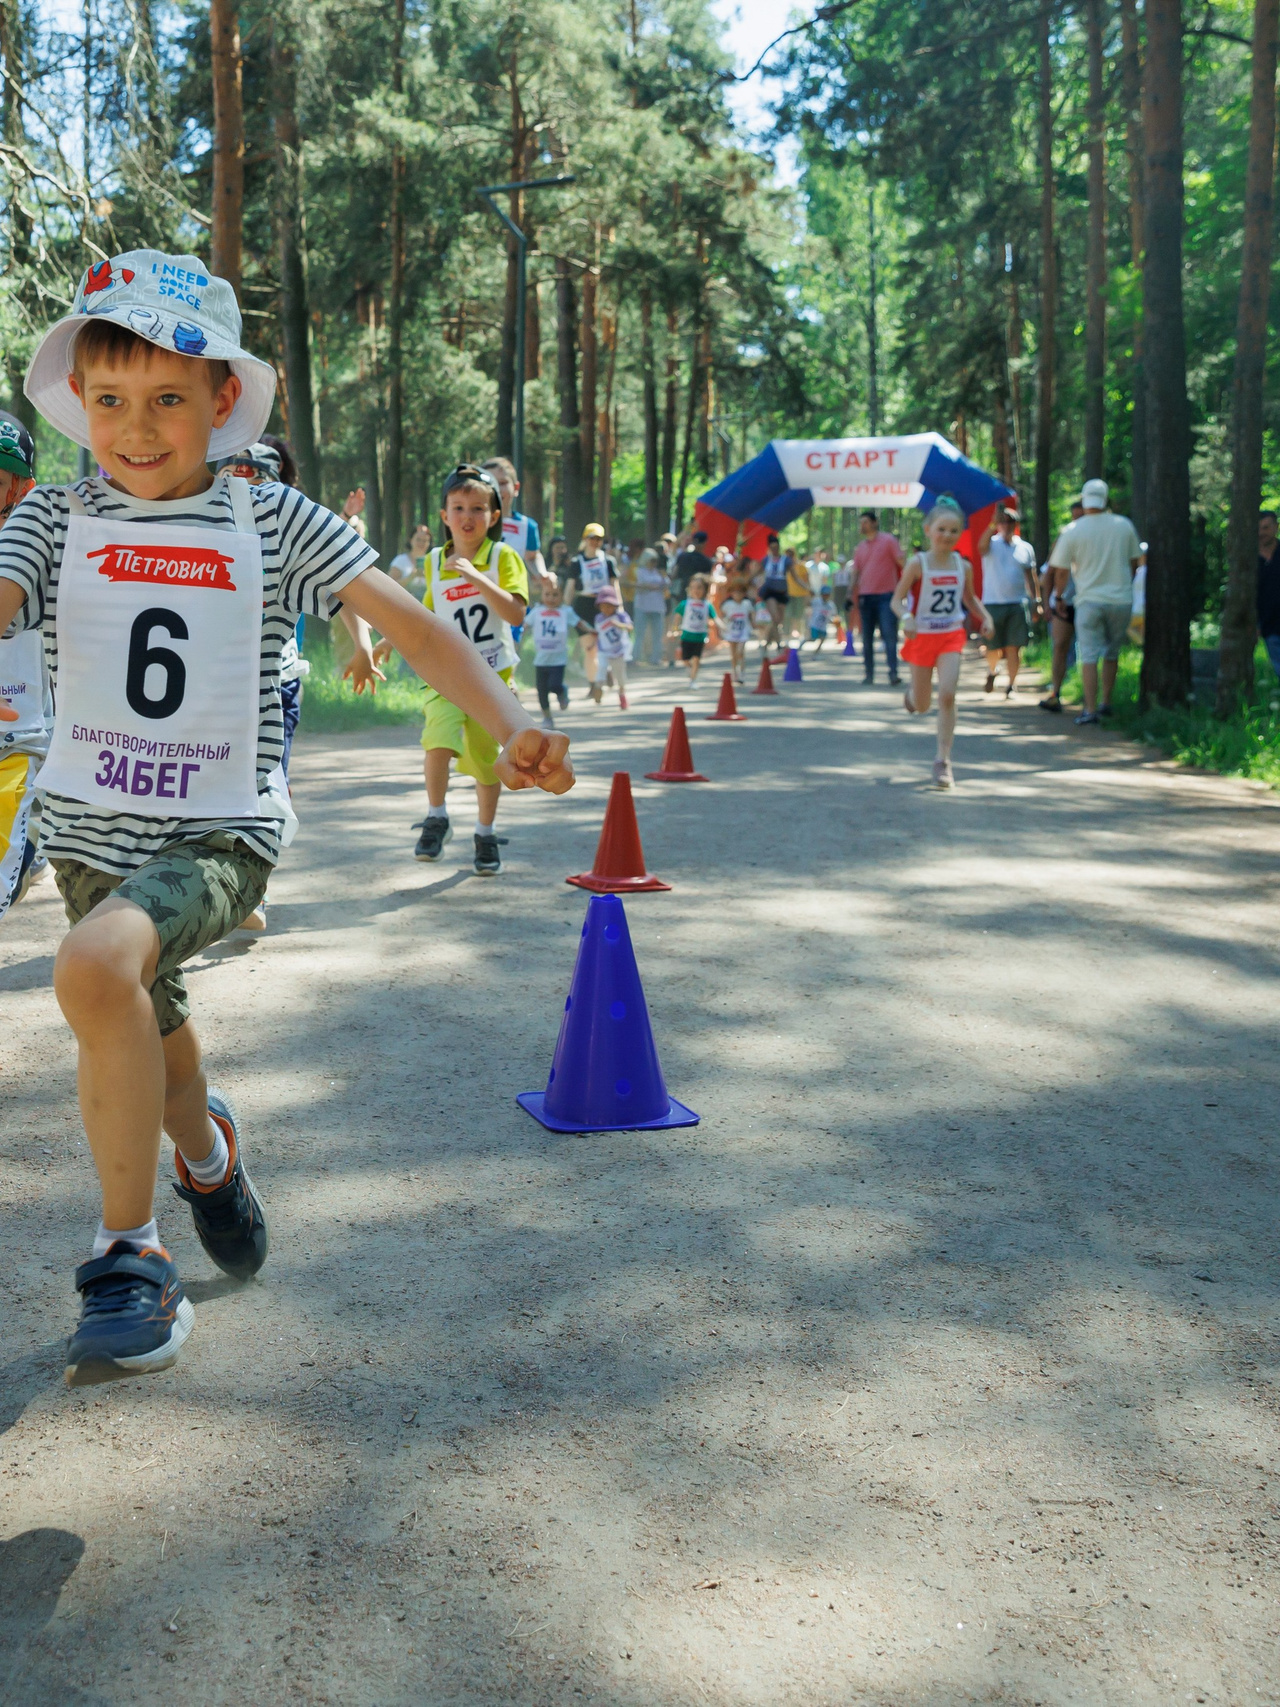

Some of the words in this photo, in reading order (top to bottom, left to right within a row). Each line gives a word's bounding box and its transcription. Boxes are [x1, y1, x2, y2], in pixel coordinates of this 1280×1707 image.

[152, 263, 157, 273] I
[162, 263, 209, 287] NEED
[159, 277, 190, 292] MORE
[158, 285, 202, 310] SPACE
[805, 448, 898, 470] СТАРТ
[930, 589, 956, 614] 23
[453, 603, 495, 644] 12
[541, 619, 557, 637] 14
[126, 607, 189, 719] 6
[71, 724, 231, 760] БЛАГОТВОРИТЕЛЬНЫЙ
[94, 749, 200, 799] ЗАБЕГ
